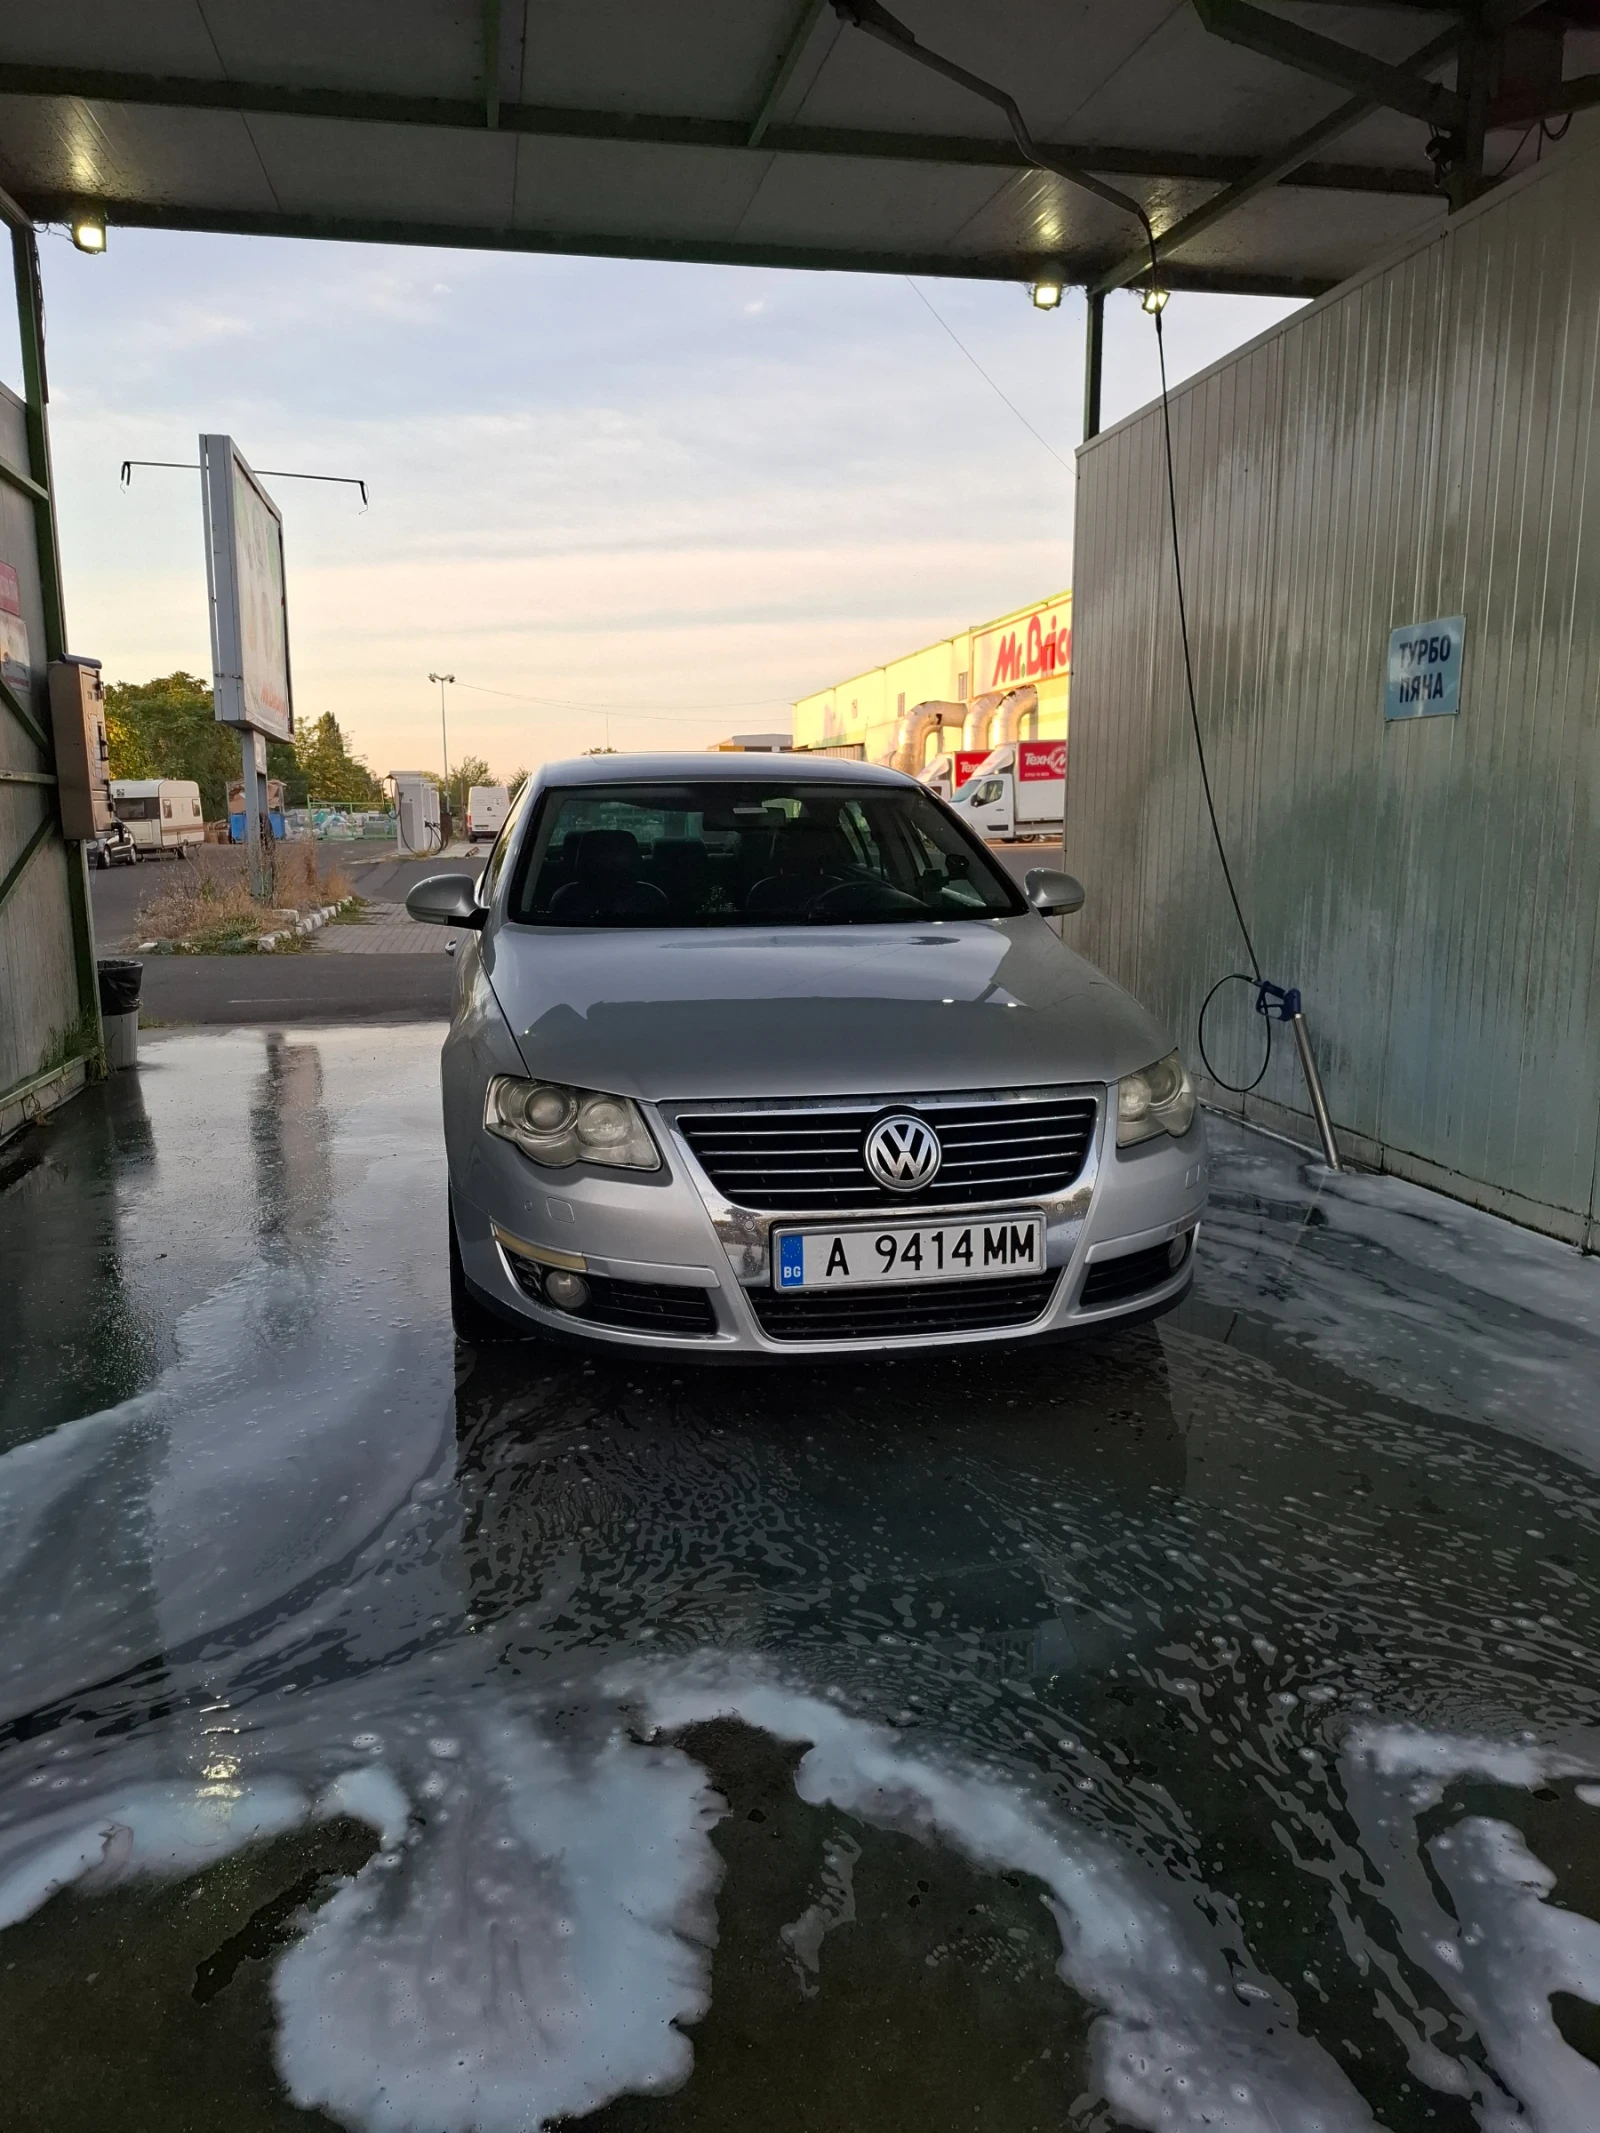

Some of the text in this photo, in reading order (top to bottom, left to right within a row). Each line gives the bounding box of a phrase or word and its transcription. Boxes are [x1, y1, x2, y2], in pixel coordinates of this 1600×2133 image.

[1399, 634, 1452, 668] ТУРБО
[1399, 672, 1443, 703] ПЯНА
[873, 1120, 936, 1186] VW
[783, 1266, 801, 1278] BG
[825, 1237, 850, 1277] A
